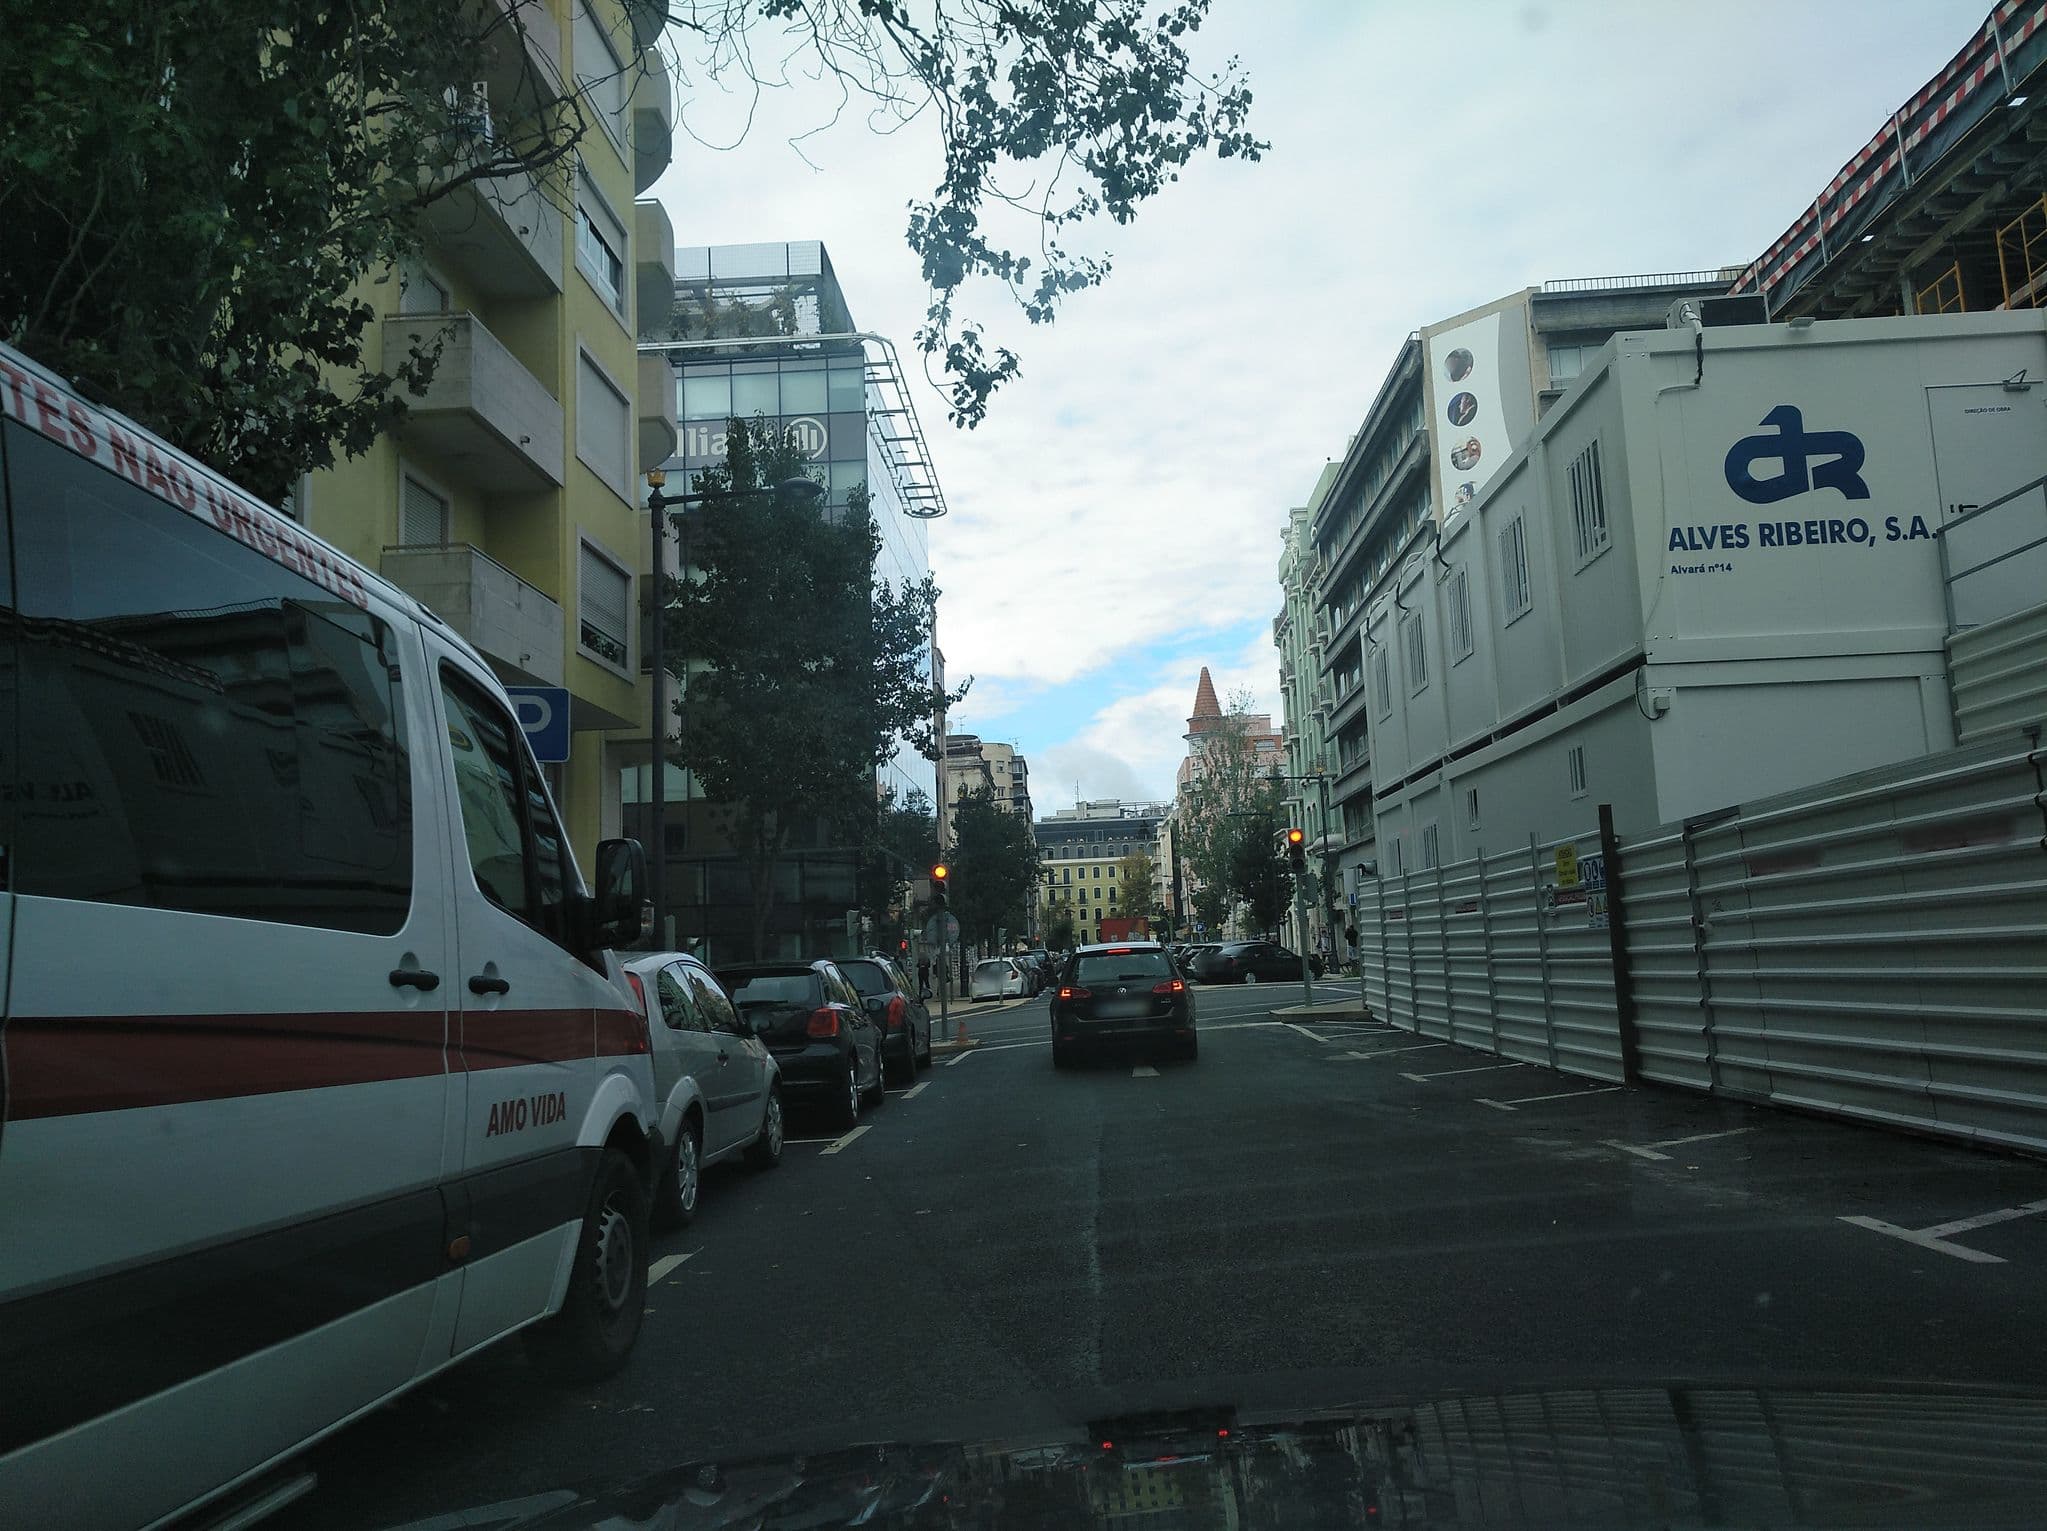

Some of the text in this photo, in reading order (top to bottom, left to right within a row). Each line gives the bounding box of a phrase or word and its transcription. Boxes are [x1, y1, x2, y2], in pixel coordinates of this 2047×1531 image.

[206, 482, 369, 609] URGENTES
[1669, 516, 1938, 551] ALVES RIBEIRO, S.A.
[1671, 564, 1705, 574] Alvará
[510, 695, 552, 732] P
[486, 1092, 566, 1137] AMO VIDA
